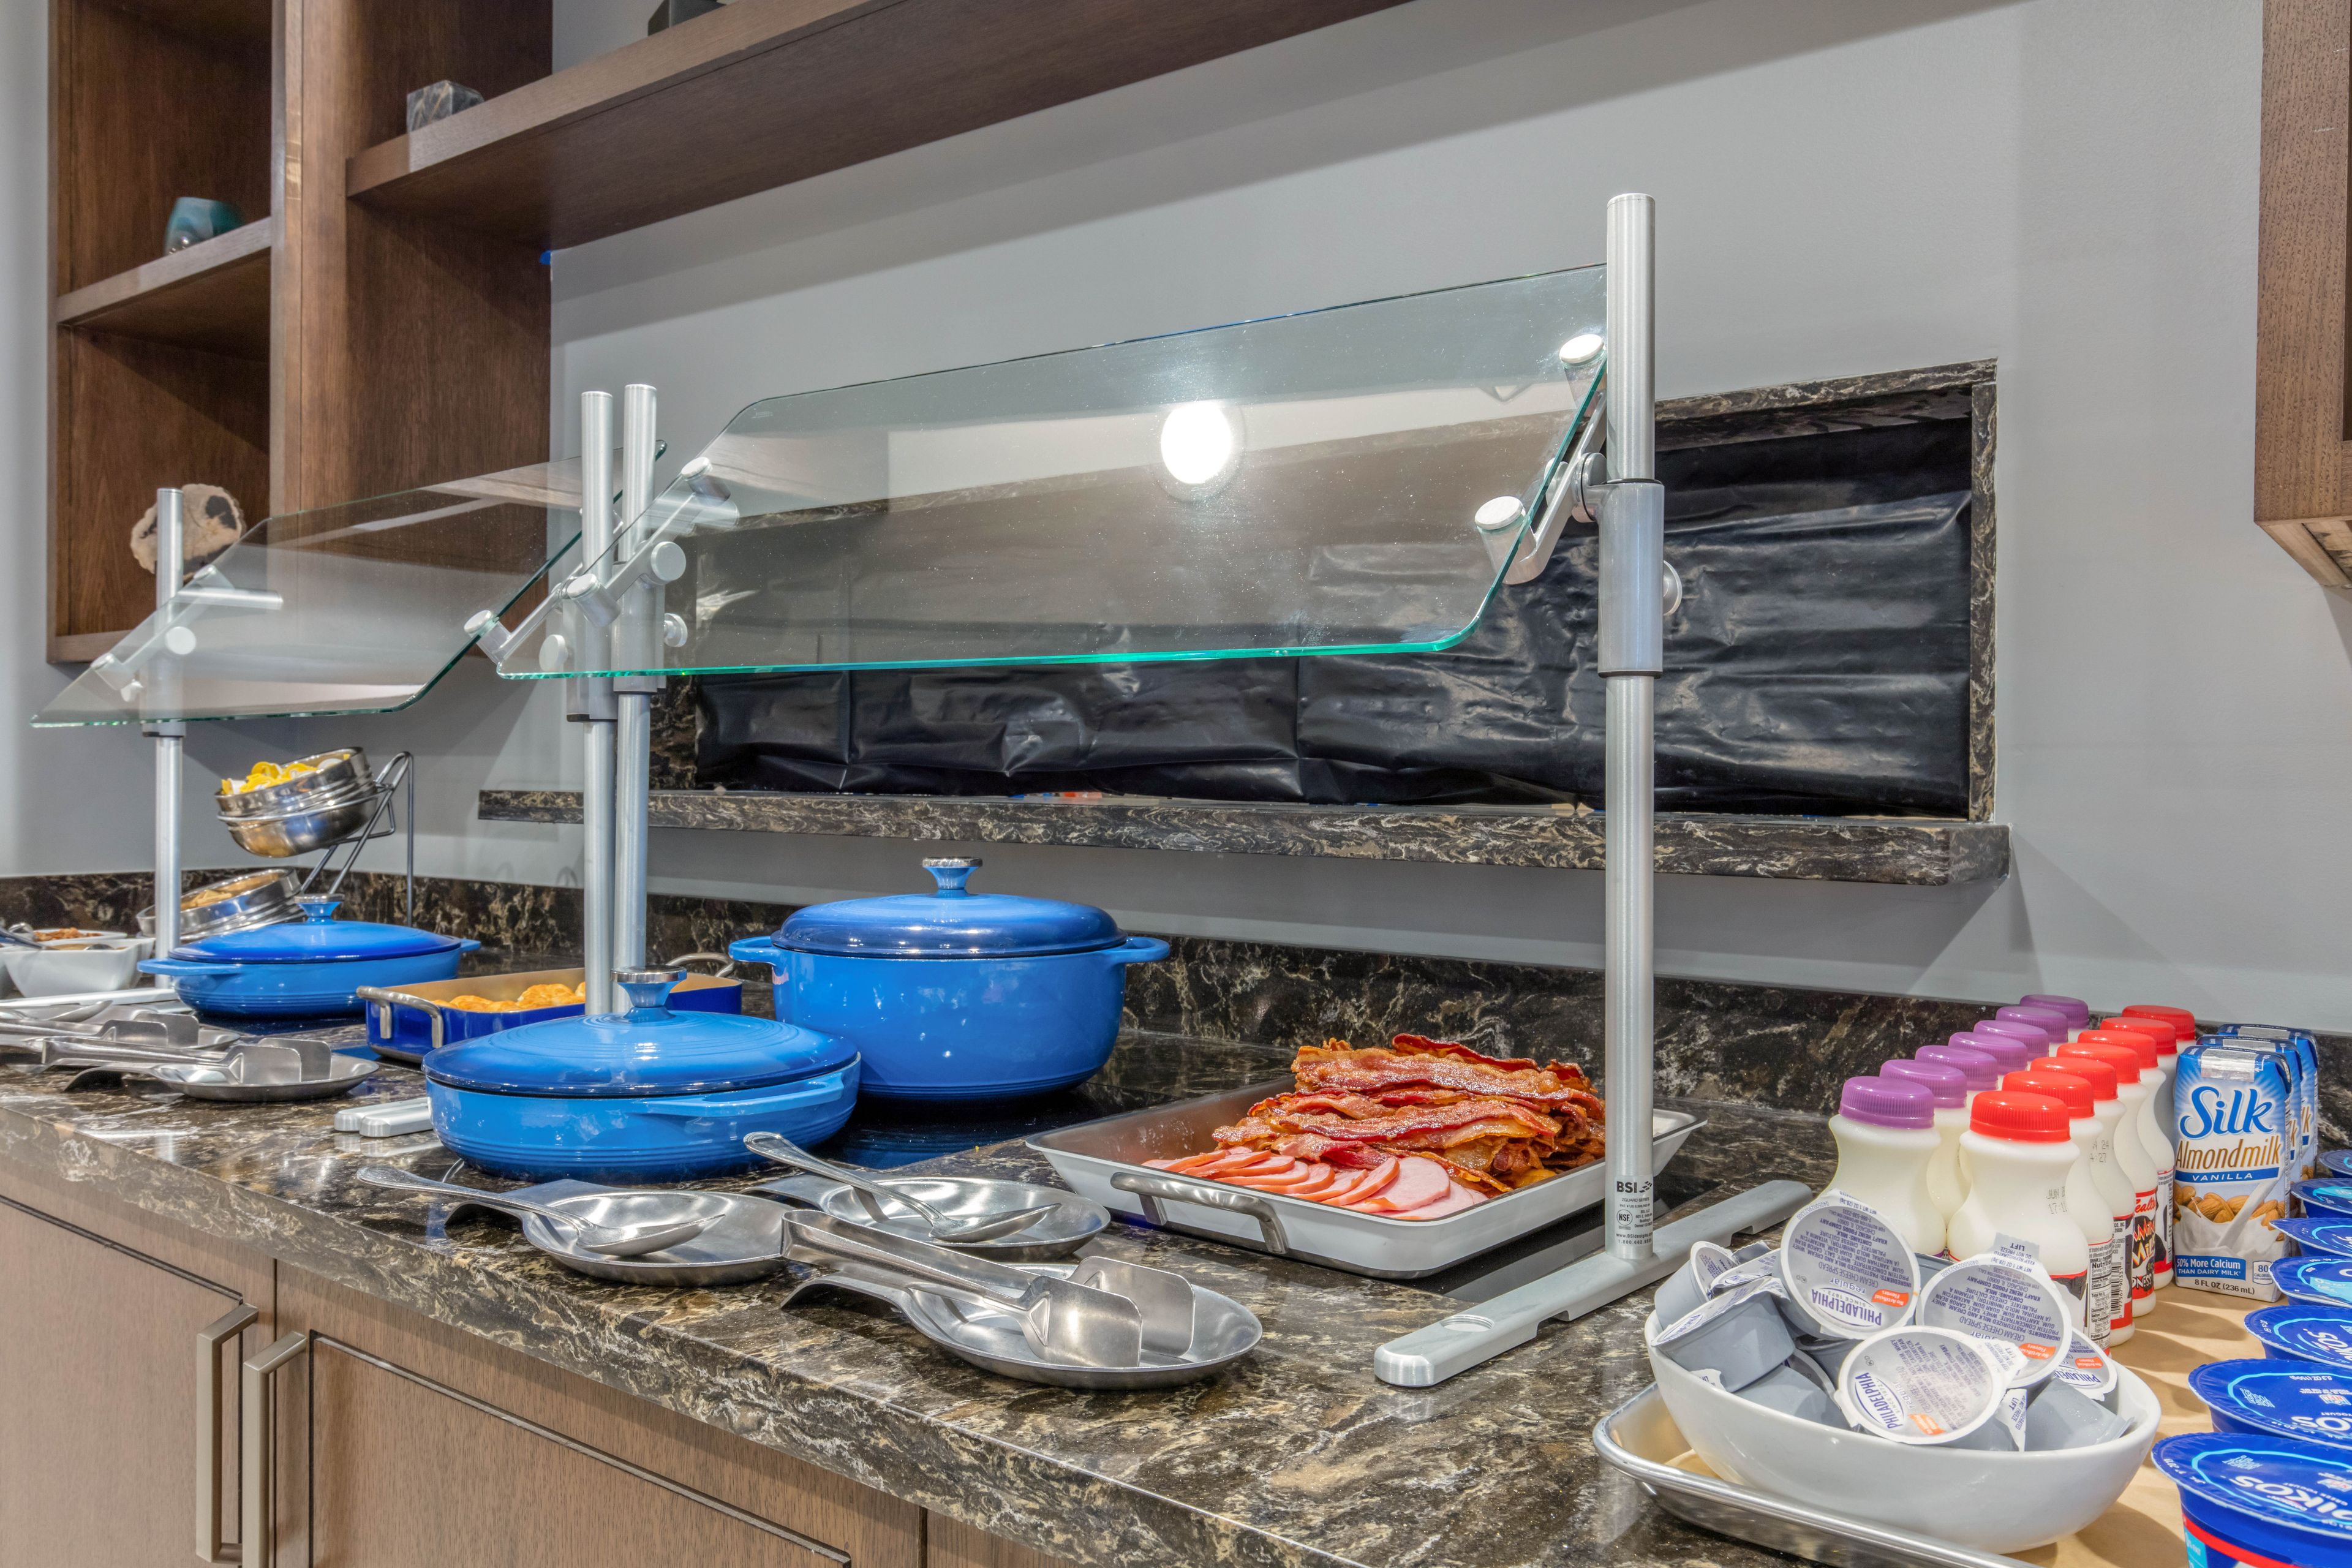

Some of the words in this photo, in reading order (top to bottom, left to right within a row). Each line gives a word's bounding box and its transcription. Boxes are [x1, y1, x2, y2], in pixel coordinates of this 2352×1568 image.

[2180, 1086, 2273, 1139] Silk
[2176, 1135, 2282, 1169] Almondmilk
[2192, 1172, 2253, 1182] VANILLA
[1616, 1181, 1637, 1193] BSI
[1819, 1217, 1842, 1229] COMPANY
[1834, 1229, 1848, 1238] MILK.
[1841, 1226, 1858, 1235] FOODS
[1854, 1223, 1875, 1235] CHICAGO,
[1799, 1234, 1825, 1248] NATAMYCIN
[1809, 1232, 1828, 1243] VITAMIN
[1819, 1230, 1840, 1241] CULTURE
[1848, 1234, 1872, 1246] CONTAINS:
[1857, 1231, 1871, 1240] HEINZ
[1871, 1235, 1888, 1245] KRAFT
[1792, 1243, 1806, 1252] WHEY
[1794, 1238, 1806, 1246] BEAN
[1806, 1242, 1823, 1253] CAROB
[1828, 1238, 1855, 1253] INHIBITOR),
[1841, 1238, 1858, 1247] CHEESE
[2010, 1242, 2025, 1251] LIFT
[1804, 1248, 1823, 1259] CREAM,
[1822, 1248, 1835, 1257] SALT,
[1825, 1244, 1839, 1253] GUM,
[1856, 1249, 1871, 1257] MOLD
[1858, 1243, 1887, 1257] PALMITATE,
[1999, 1246, 2015, 1255] FREEZE
[1836, 1253, 1852, 1263] WHEY,
[1853, 1253, 1866, 1262] GUM,
[1871, 1254, 1893, 1264] NATURAL
[1817, 1261, 1839, 1275] SPREAD
[1852, 1259, 1887, 1275] CONCENTRATE,
[1866, 1258, 1890, 1269] XANTHAN
[1890, 1264, 1904, 1274] GUM,
[2177, 1259, 2188, 1267] 50%
[2190, 1259, 2208, 1267] More
[2211, 1259, 2241, 1270] Calcium
[1838, 1268, 1859, 1281] CHEESE
[1847, 1264, 1879, 1278] PASTEURIZED
[1887, 1270, 1909, 1281] PROTEIN
[1829, 1276, 1866, 1294] regular
[1858, 1275, 1879, 1287] CREAM
[1879, 1274, 1912, 1287] INGREDIENTS:
[1966, 1275, 1991, 1287] COMPANY
[1992, 1283, 2008, 1292] FOODS
[2005, 1281, 2029, 1292] CHICAGO,
[2223, 1283, 2239, 1292] (236
[1935, 1293, 1948, 1302] BEAN
[1942, 1290, 1970, 1303] NATAMYCIN
[1954, 1289, 1974, 1299] VITAMIN
[1965, 1287, 1988, 1298] CULTURE
[1998, 1291, 2023, 1303] CONTAINS:
[1931, 1297, 1947, 1306] WHEY
[1949, 1298, 1966, 1308] CAROB
[1975, 1295, 2004, 1308] INHIBITOR),
[1988, 1294, 2008, 1304] CHEESE
[1812, 1289, 1880, 1325] PHILADELPHIA
[1947, 1303, 1967, 1314] CREAM,
[1985, 1305, 2000, 1313] GUAR
[2008, 1300, 2037, 1313] PALMITATE,
[1981, 1309, 1997, 1318] WHEY,
[2021, 1310, 2044, 1320] NATURAL
[1958, 1316, 1981, 1329] SPREAD
[1998, 1314, 2036, 1330] CONCENTRATE,
[2015, 1314, 2039, 1325] XANTHAN
[1981, 1323, 2003, 1335] CHEESE
[1992, 1319, 2026, 1333] PASTEURIZED
[2037, 1326, 2059, 1335] PROTEIN
[2003, 1330, 2025, 1341] CREAM
[2026, 1329, 2060, 1341] INGREDIENTS:
[1890, 1338, 1901, 1352] WHEY
[1897, 1337, 1908, 1350] BEAN
[1904, 1349, 1916, 1363] CAROB
[1905, 1340, 1923, 1363] NATAMYCIN
[1939, 1343, 1955, 1363] COMPANY
[2004, 1346, 2016, 1359] LIFT
[1855, 1371, 1903, 1430] PHILADELPHIA
[1892, 1381, 1916, 1409] regular
[2008, 1397, 2019, 1411] LIFT
[2283, 1482, 2318, 1495] YOGURT
[2321, 1493, 2348, 1506] GREEK
